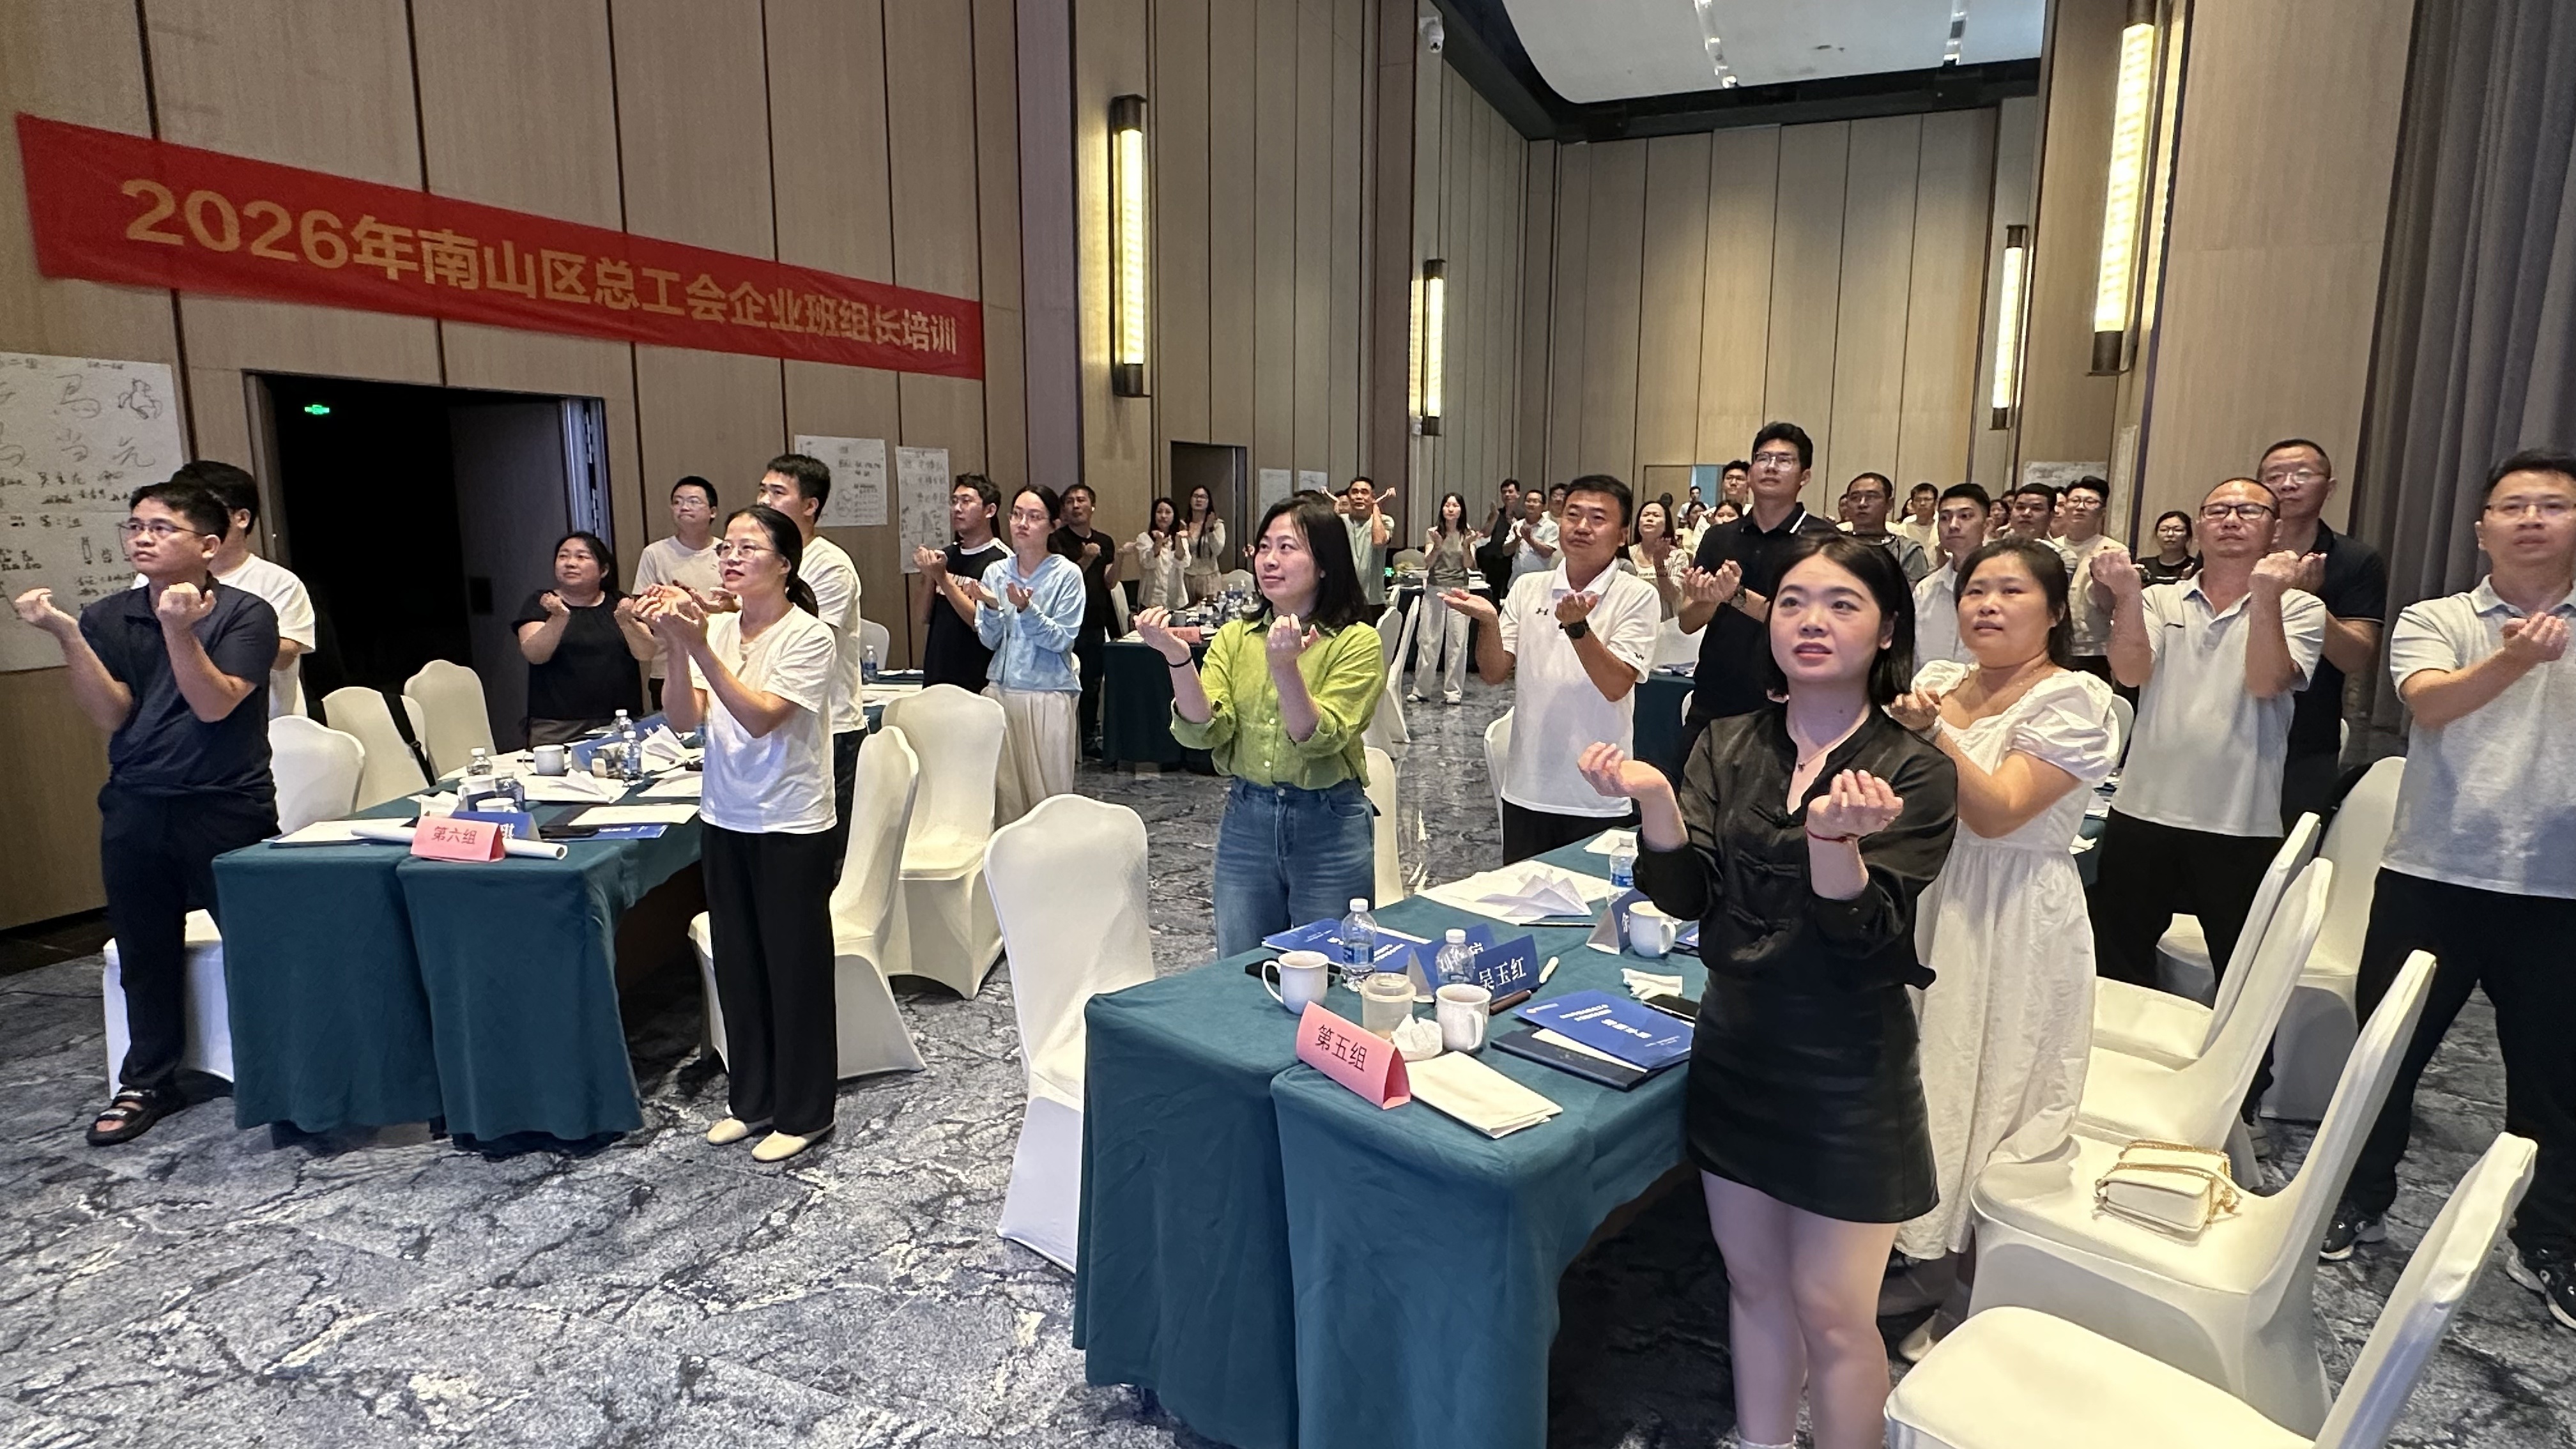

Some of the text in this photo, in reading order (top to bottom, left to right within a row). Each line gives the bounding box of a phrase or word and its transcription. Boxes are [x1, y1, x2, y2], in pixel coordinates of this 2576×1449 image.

[121, 178, 957, 355] 2026年南山区总工会企业班组长培训
[431, 826, 478, 845] 第六组
[1478, 956, 1527, 990] 吴玉红
[1315, 1023, 1367, 1072] 第五组
